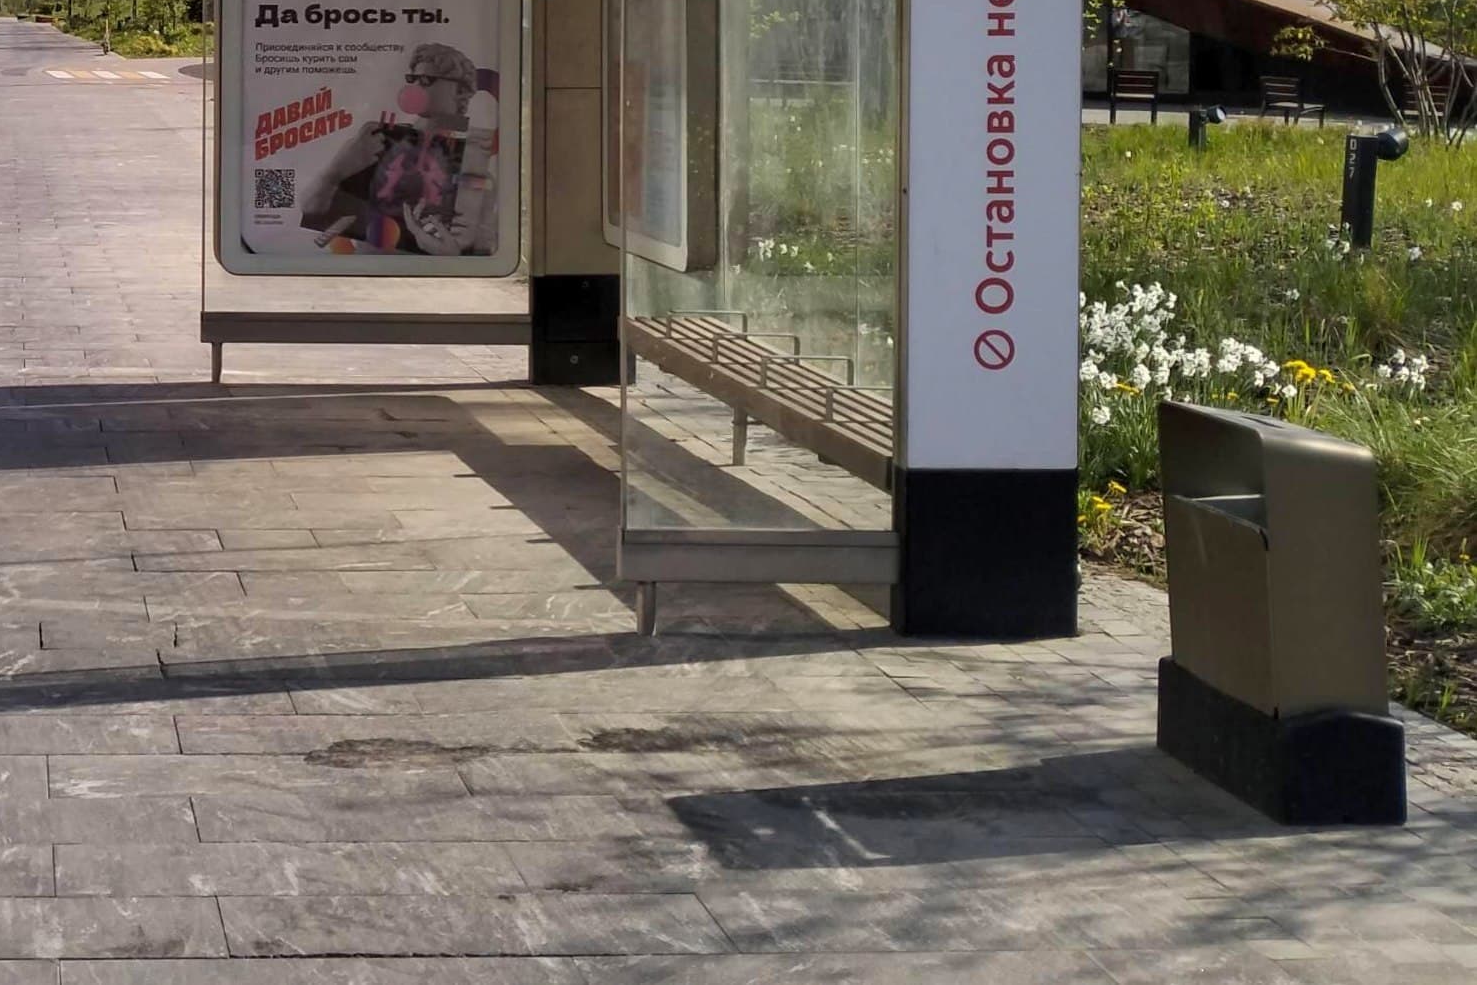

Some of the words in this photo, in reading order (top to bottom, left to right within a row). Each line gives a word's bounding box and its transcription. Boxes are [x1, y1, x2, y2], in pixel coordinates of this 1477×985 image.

[255, 4, 299, 28] Да
[304, 3, 396, 29] брось
[401, 8, 450, 24] ты.
[255, 86, 332, 139] ДАВАЙ
[255, 109, 353, 161] БРОСАТЬ
[975, 53, 1016, 315] Остановка
